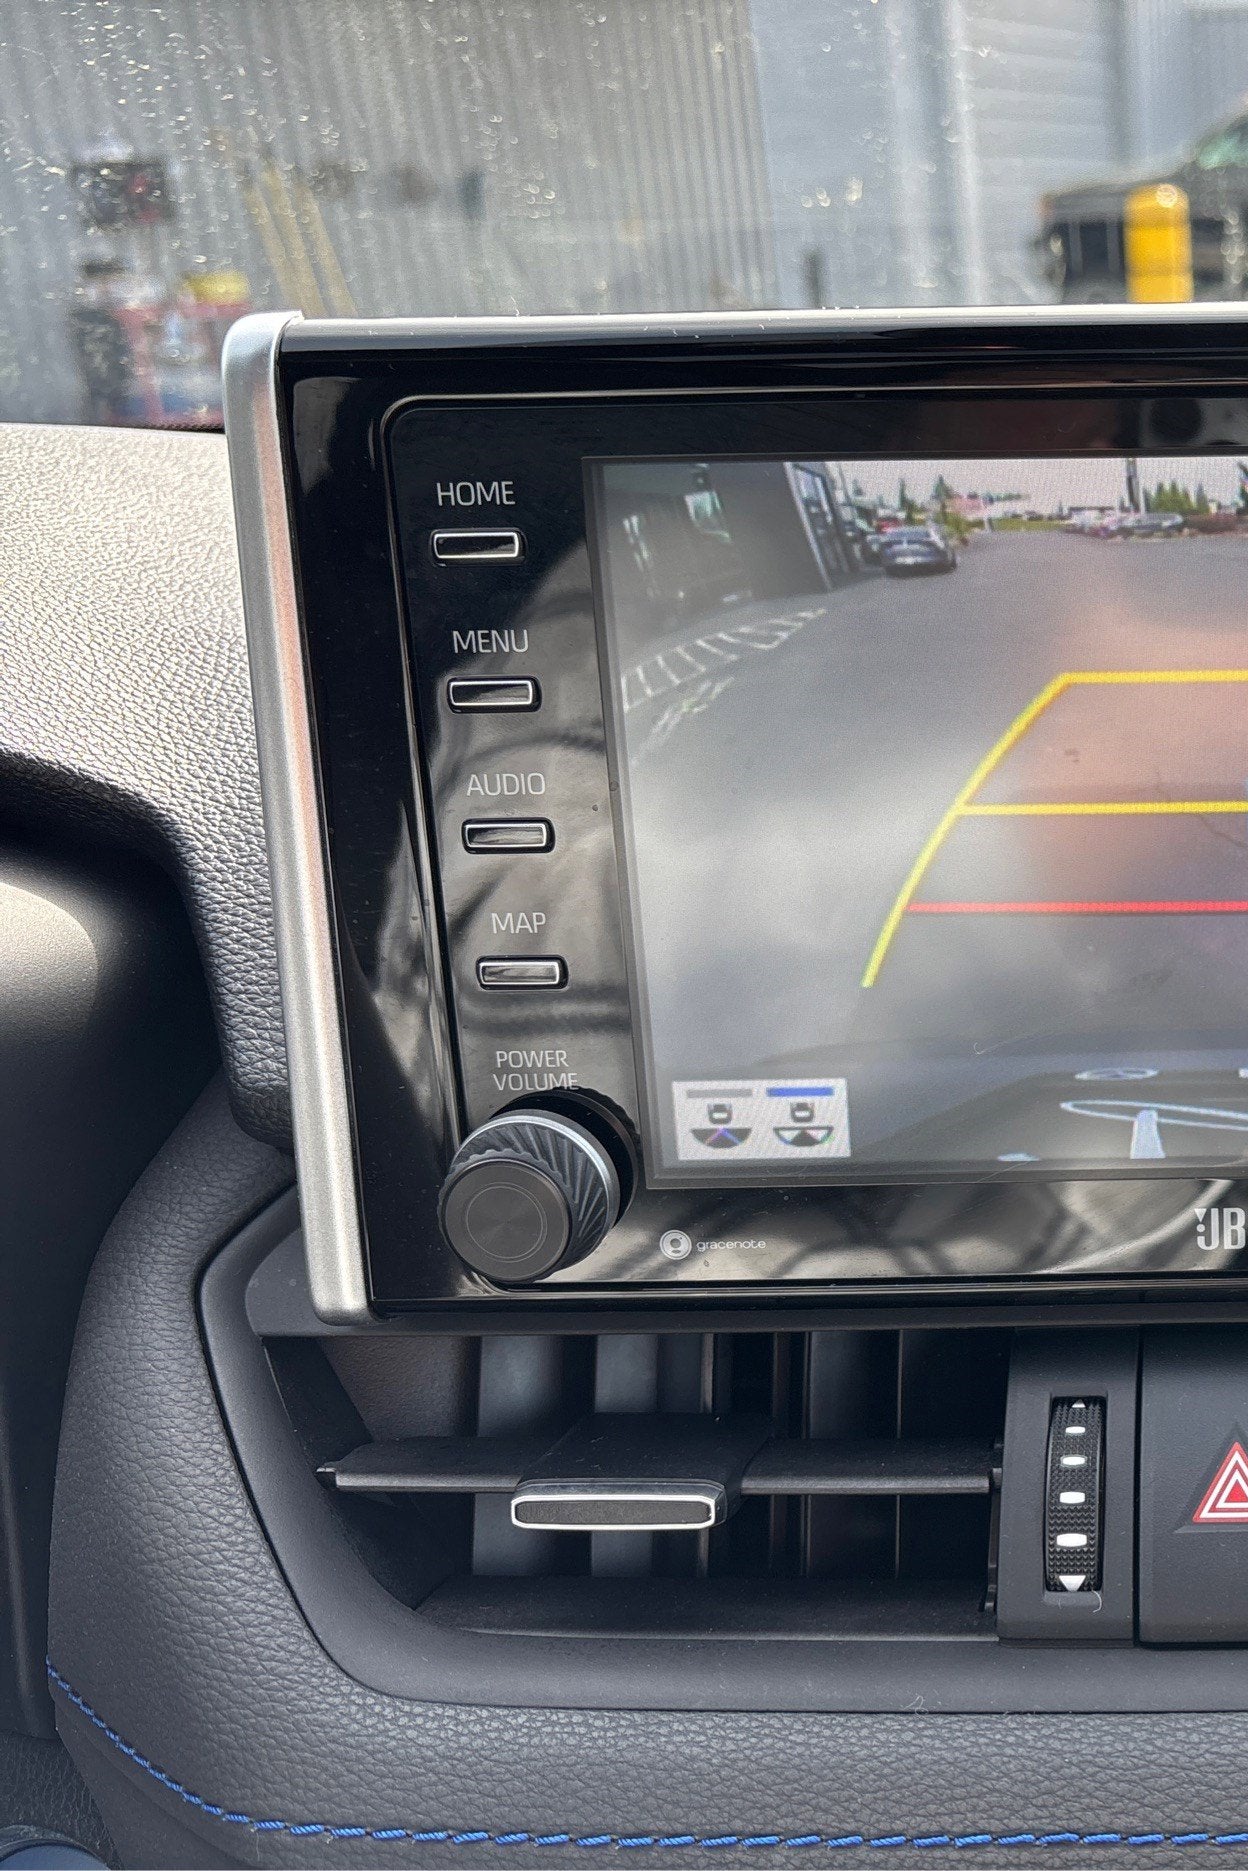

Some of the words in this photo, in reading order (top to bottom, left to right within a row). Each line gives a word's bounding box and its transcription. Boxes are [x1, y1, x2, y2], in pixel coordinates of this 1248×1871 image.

[436, 481, 516, 506] HOME
[452, 630, 530, 654] MENU
[466, 773, 546, 797] AUDIO
[491, 912, 547, 935] MAP
[496, 1050, 569, 1068] POWER
[492, 1072, 580, 1091] VOLUME
[696, 1239, 767, 1252] gracenote
